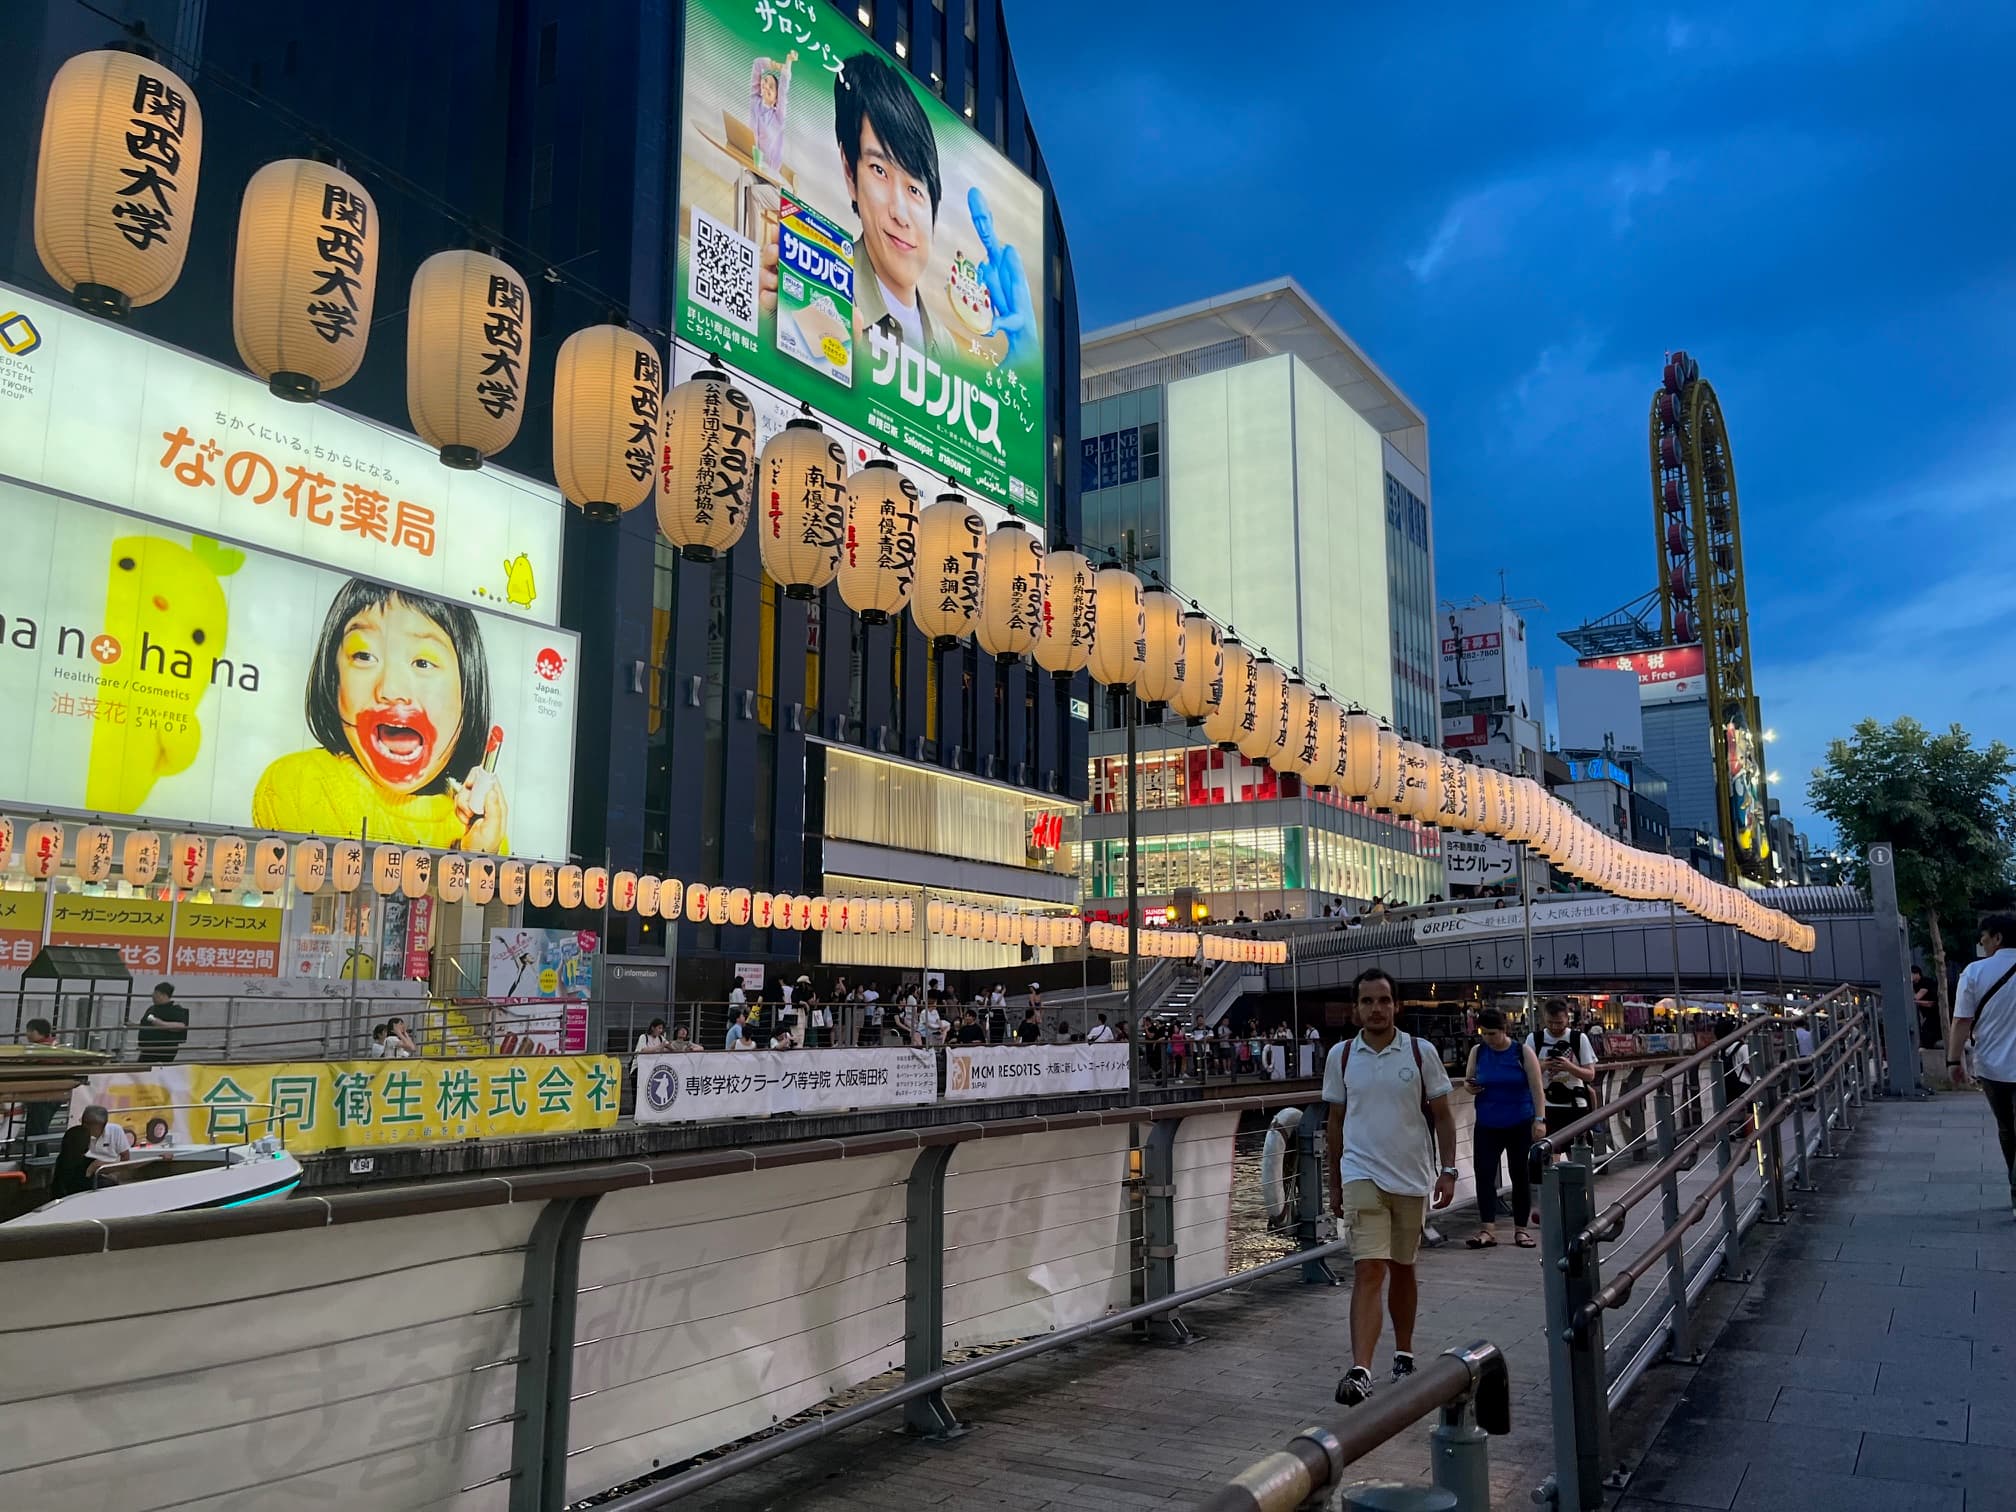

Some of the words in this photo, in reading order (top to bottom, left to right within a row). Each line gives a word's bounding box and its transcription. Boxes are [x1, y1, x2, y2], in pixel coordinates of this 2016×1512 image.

[112, 74, 186, 252] 関西大学
[307, 183, 368, 345] 関西大学
[784, 232, 853, 297] サロンパス
[686, 306, 759, 352] 詳しい商品情報は
[686, 319, 723, 346] こちらへ
[477, 273, 525, 420] 関西大学
[869, 323, 1003, 454] サロンパス
[625, 350, 661, 483] 関西大学
[215, 410, 400, 486] ちかくにいる。ちからになる。
[159, 426, 435, 557] なの花薬局
[940, 556, 959, 613] 南調会
[1616, 654, 1665, 672] 免税
[54, 667, 119, 689] Healthcare
[132, 681, 190, 701] Cosmetics
[1651, 670, 1676, 682] Free
[535, 682, 559, 695] Japan
[50, 692, 128, 725] 油菜花
[136, 706, 188, 723] TAX-FREE
[538, 705, 556, 717] Shop
[136, 717, 187, 734] SHOP
[388, 852, 400, 866] 田
[385, 867, 400, 879] NS
[449, 877, 464, 888] 20
[480, 879, 494, 890] 23
[55, 906, 165, 925] オーガニックコスメ
[189, 913, 267, 930] ブランドコスメ
[176, 949, 274, 970] 体験型空間
[1474, 953, 1580, 970] えびす橋
[624, 968, 657, 978] information
[202, 1064, 618, 1135] 合同衛生株式会社
